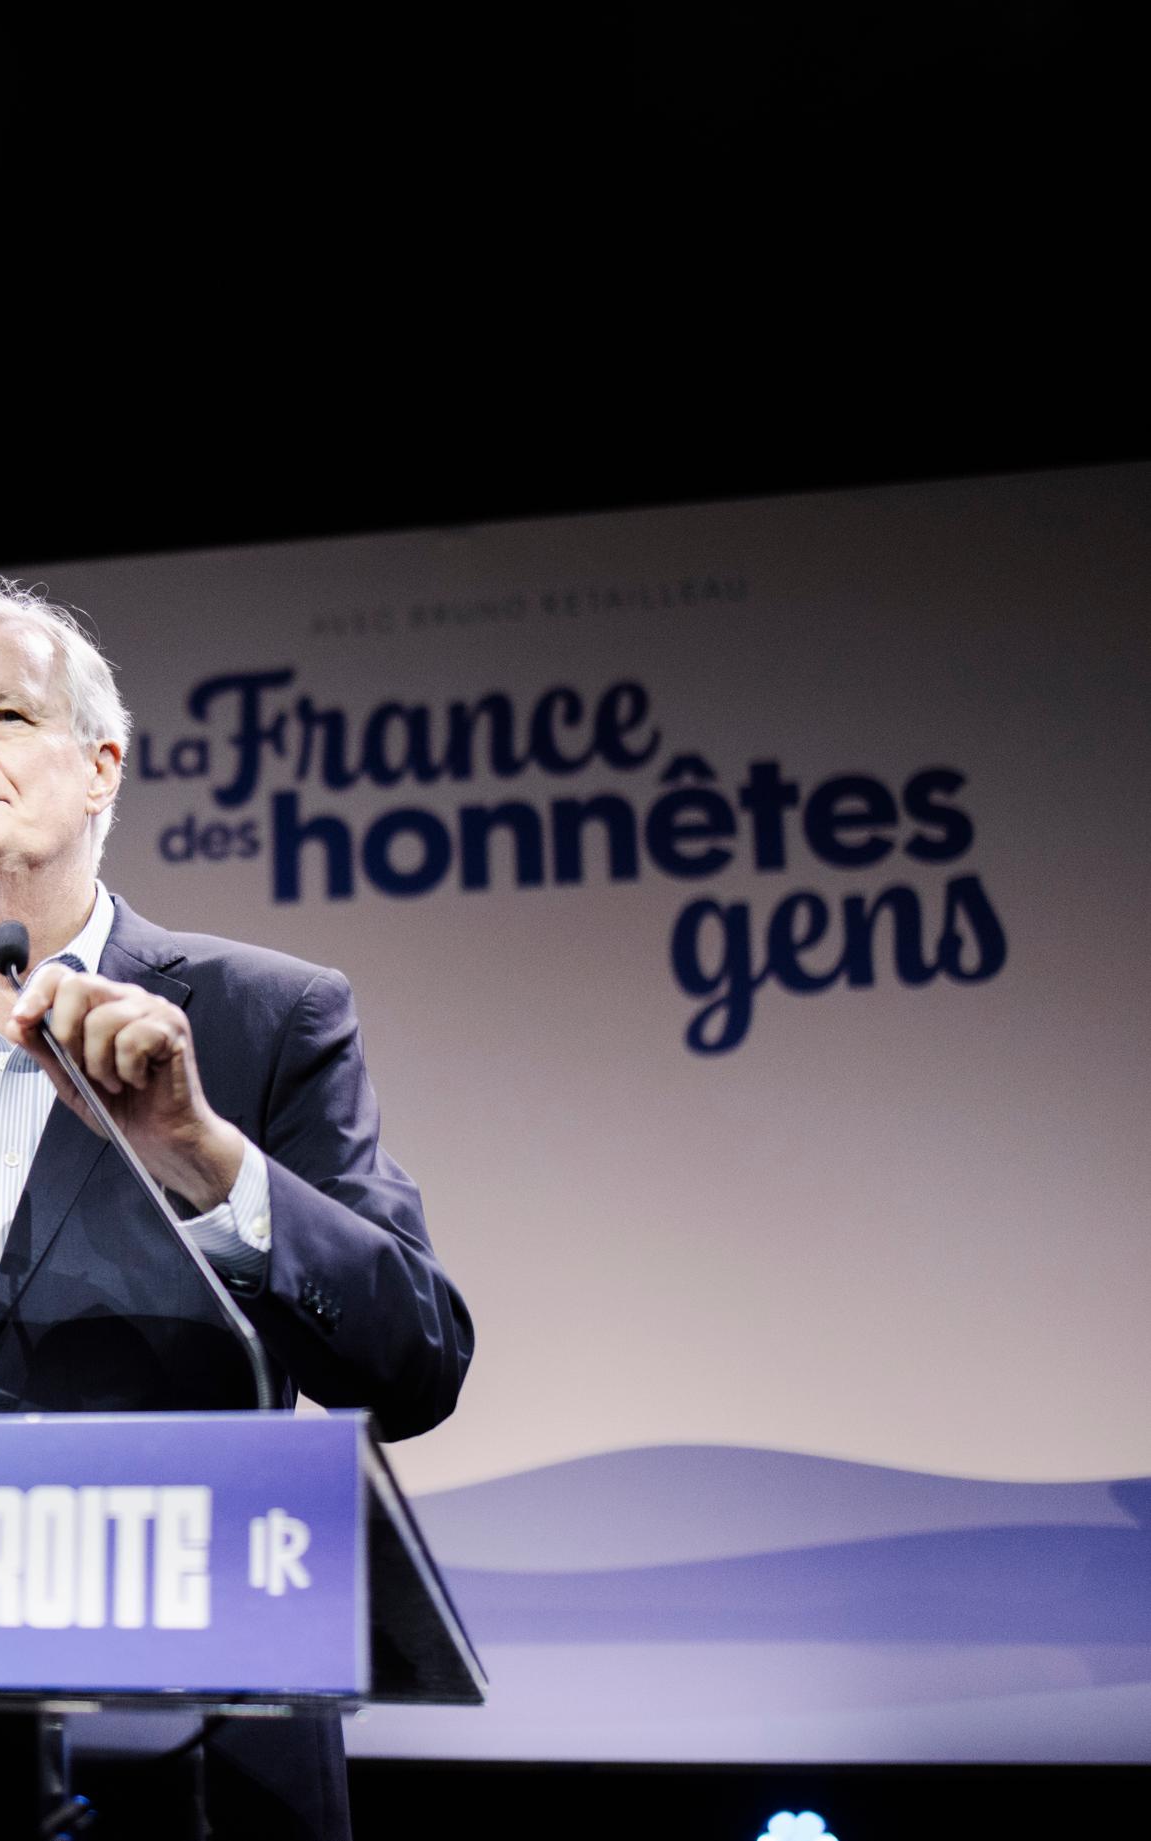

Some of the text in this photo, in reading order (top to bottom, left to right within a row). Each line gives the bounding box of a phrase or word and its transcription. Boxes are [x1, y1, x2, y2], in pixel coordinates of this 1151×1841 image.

[408, 593, 527, 629] BRUNO
[539, 576, 748, 617] RETAILLEAU
[137, 668, 662, 809] La France
[159, 755, 976, 906] des honnêtes
[670, 873, 1009, 1056] gens
